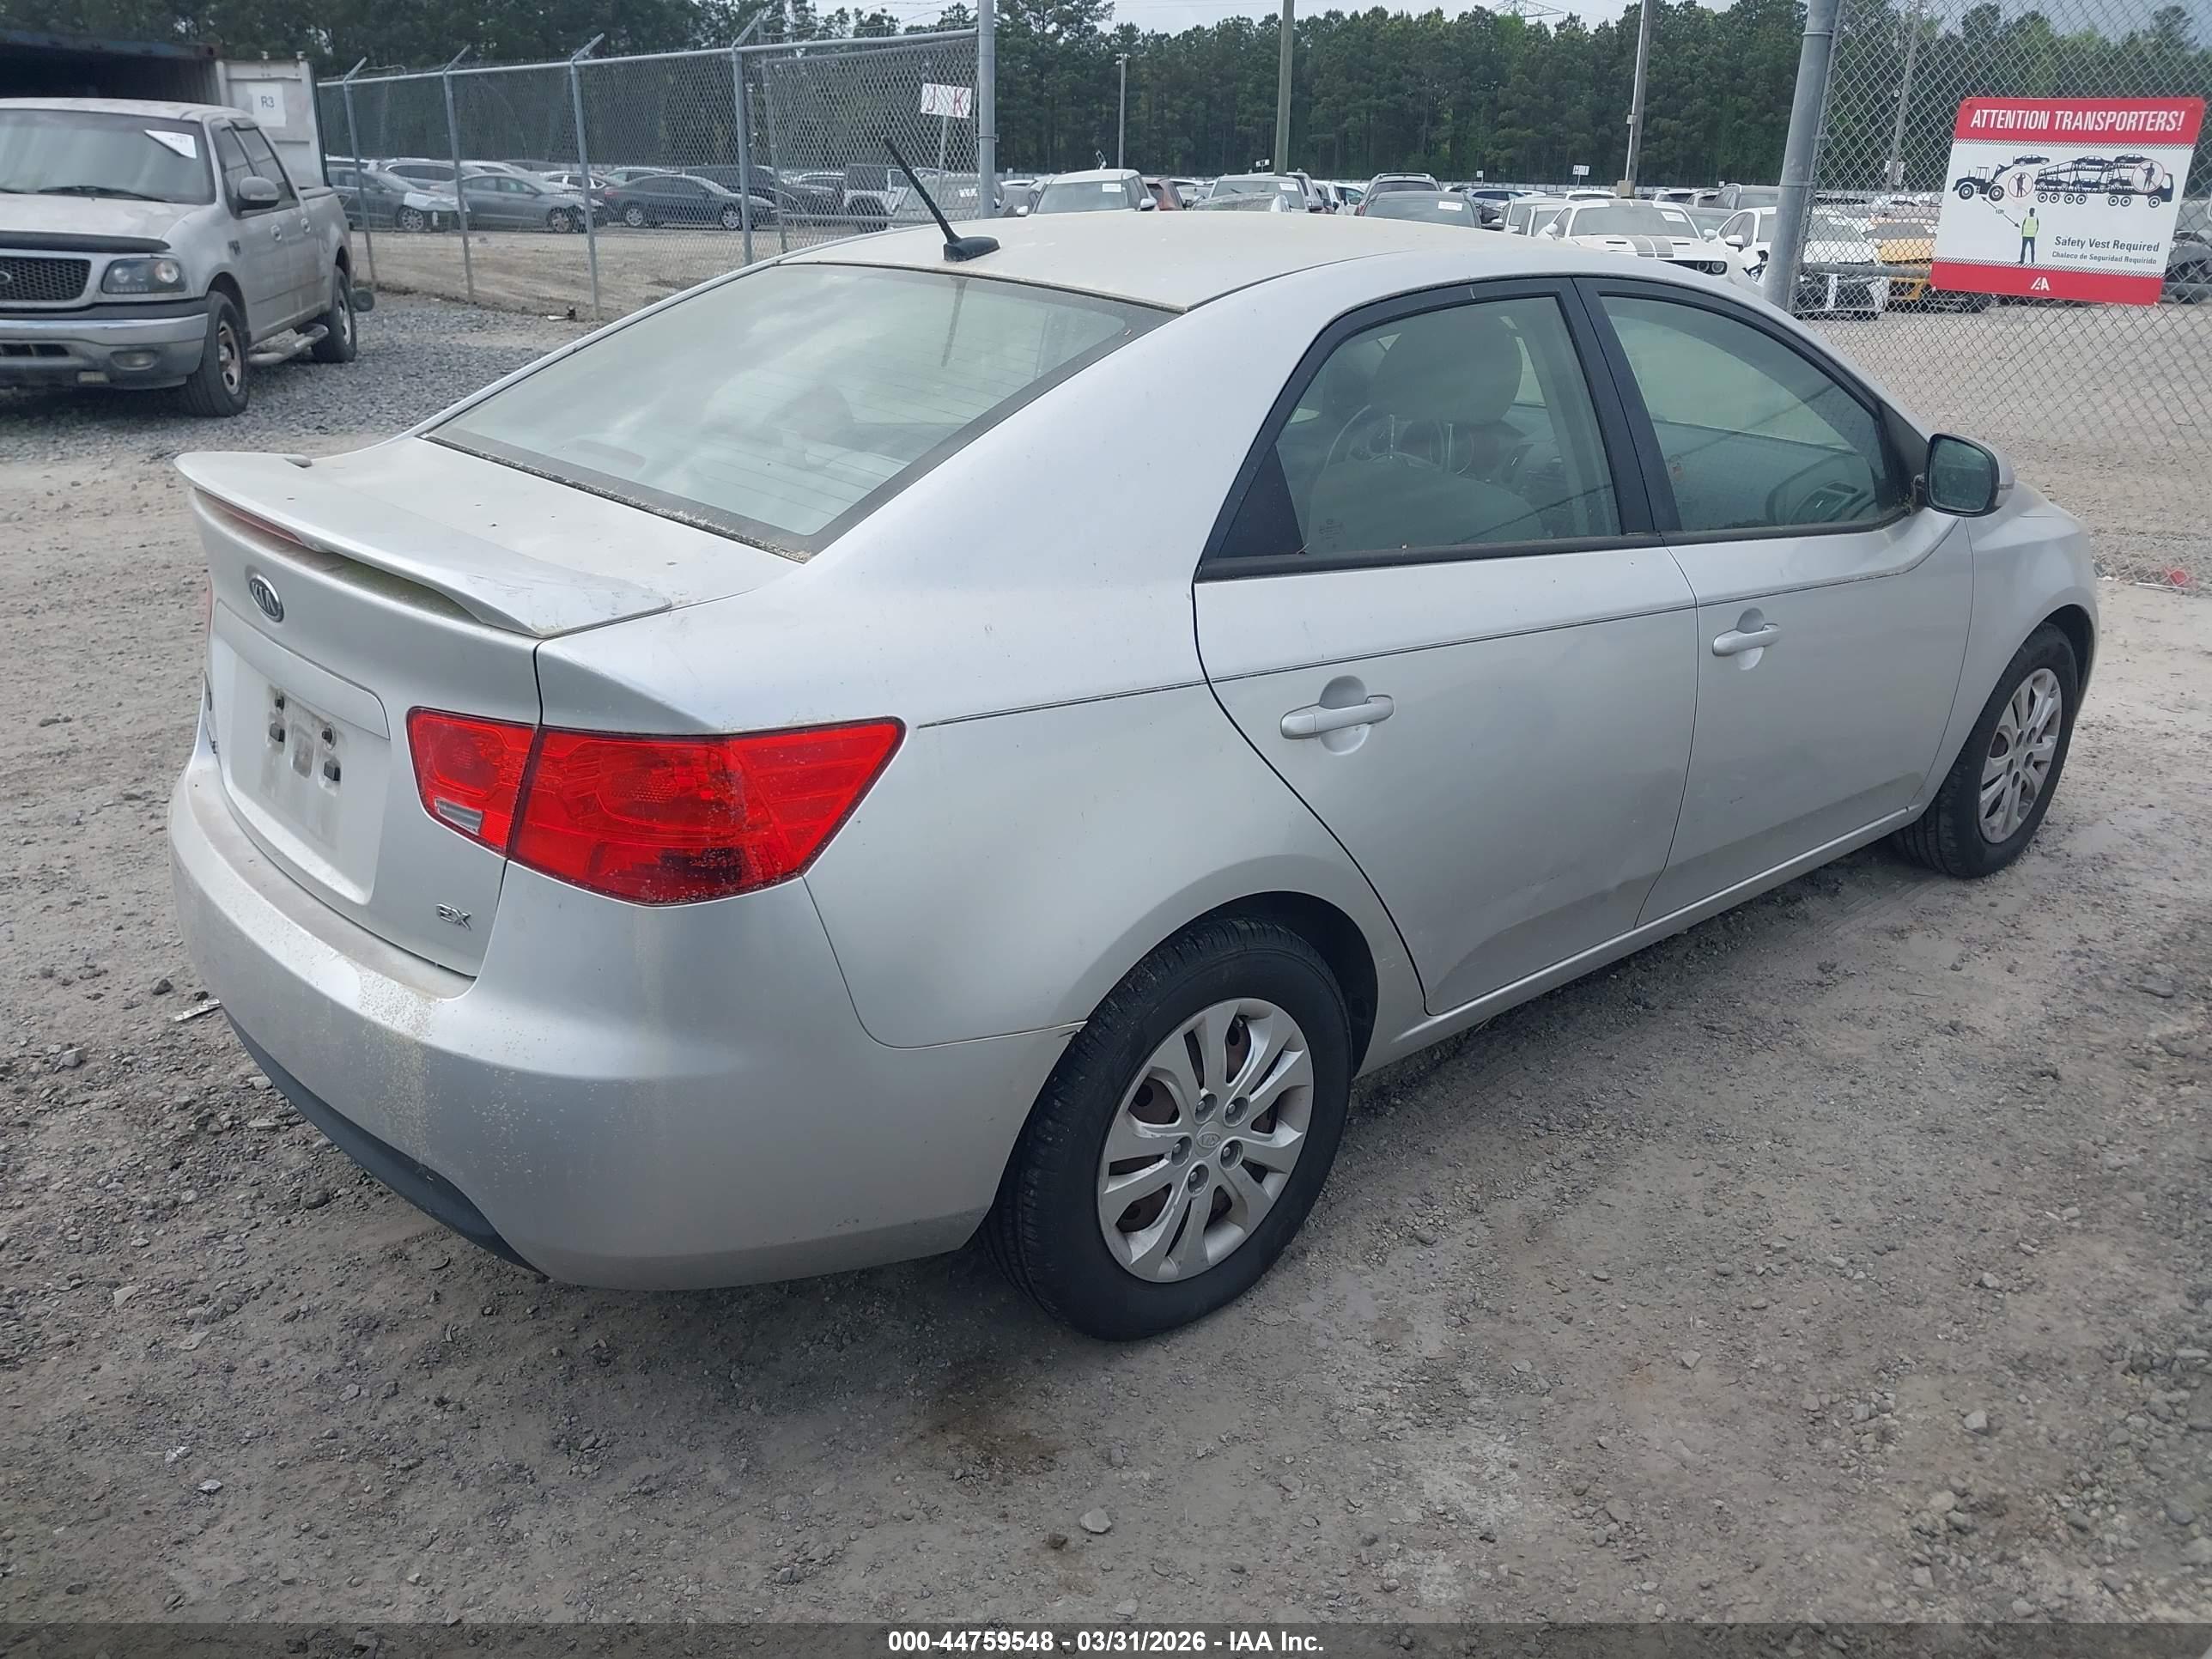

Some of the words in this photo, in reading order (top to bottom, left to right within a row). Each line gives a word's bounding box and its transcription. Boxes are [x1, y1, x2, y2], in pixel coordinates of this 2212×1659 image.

[927, 84, 937, 112] J
[953, 88, 966, 116] K
[1971, 109, 2051, 130] ATTENTION
[2054, 110, 2185, 132] TRANSPORTERS!
[2054, 235, 2086, 249] Safety
[2088, 238, 2111, 249] Vest
[2112, 240, 2160, 252] Required
[2051, 251, 2078, 259] Chaleco
[2088, 253, 2123, 263] Seguridad
[2124, 256, 2157, 264] Requirido
[251, 581, 277, 616] KIA
[435, 902, 472, 931] EX
